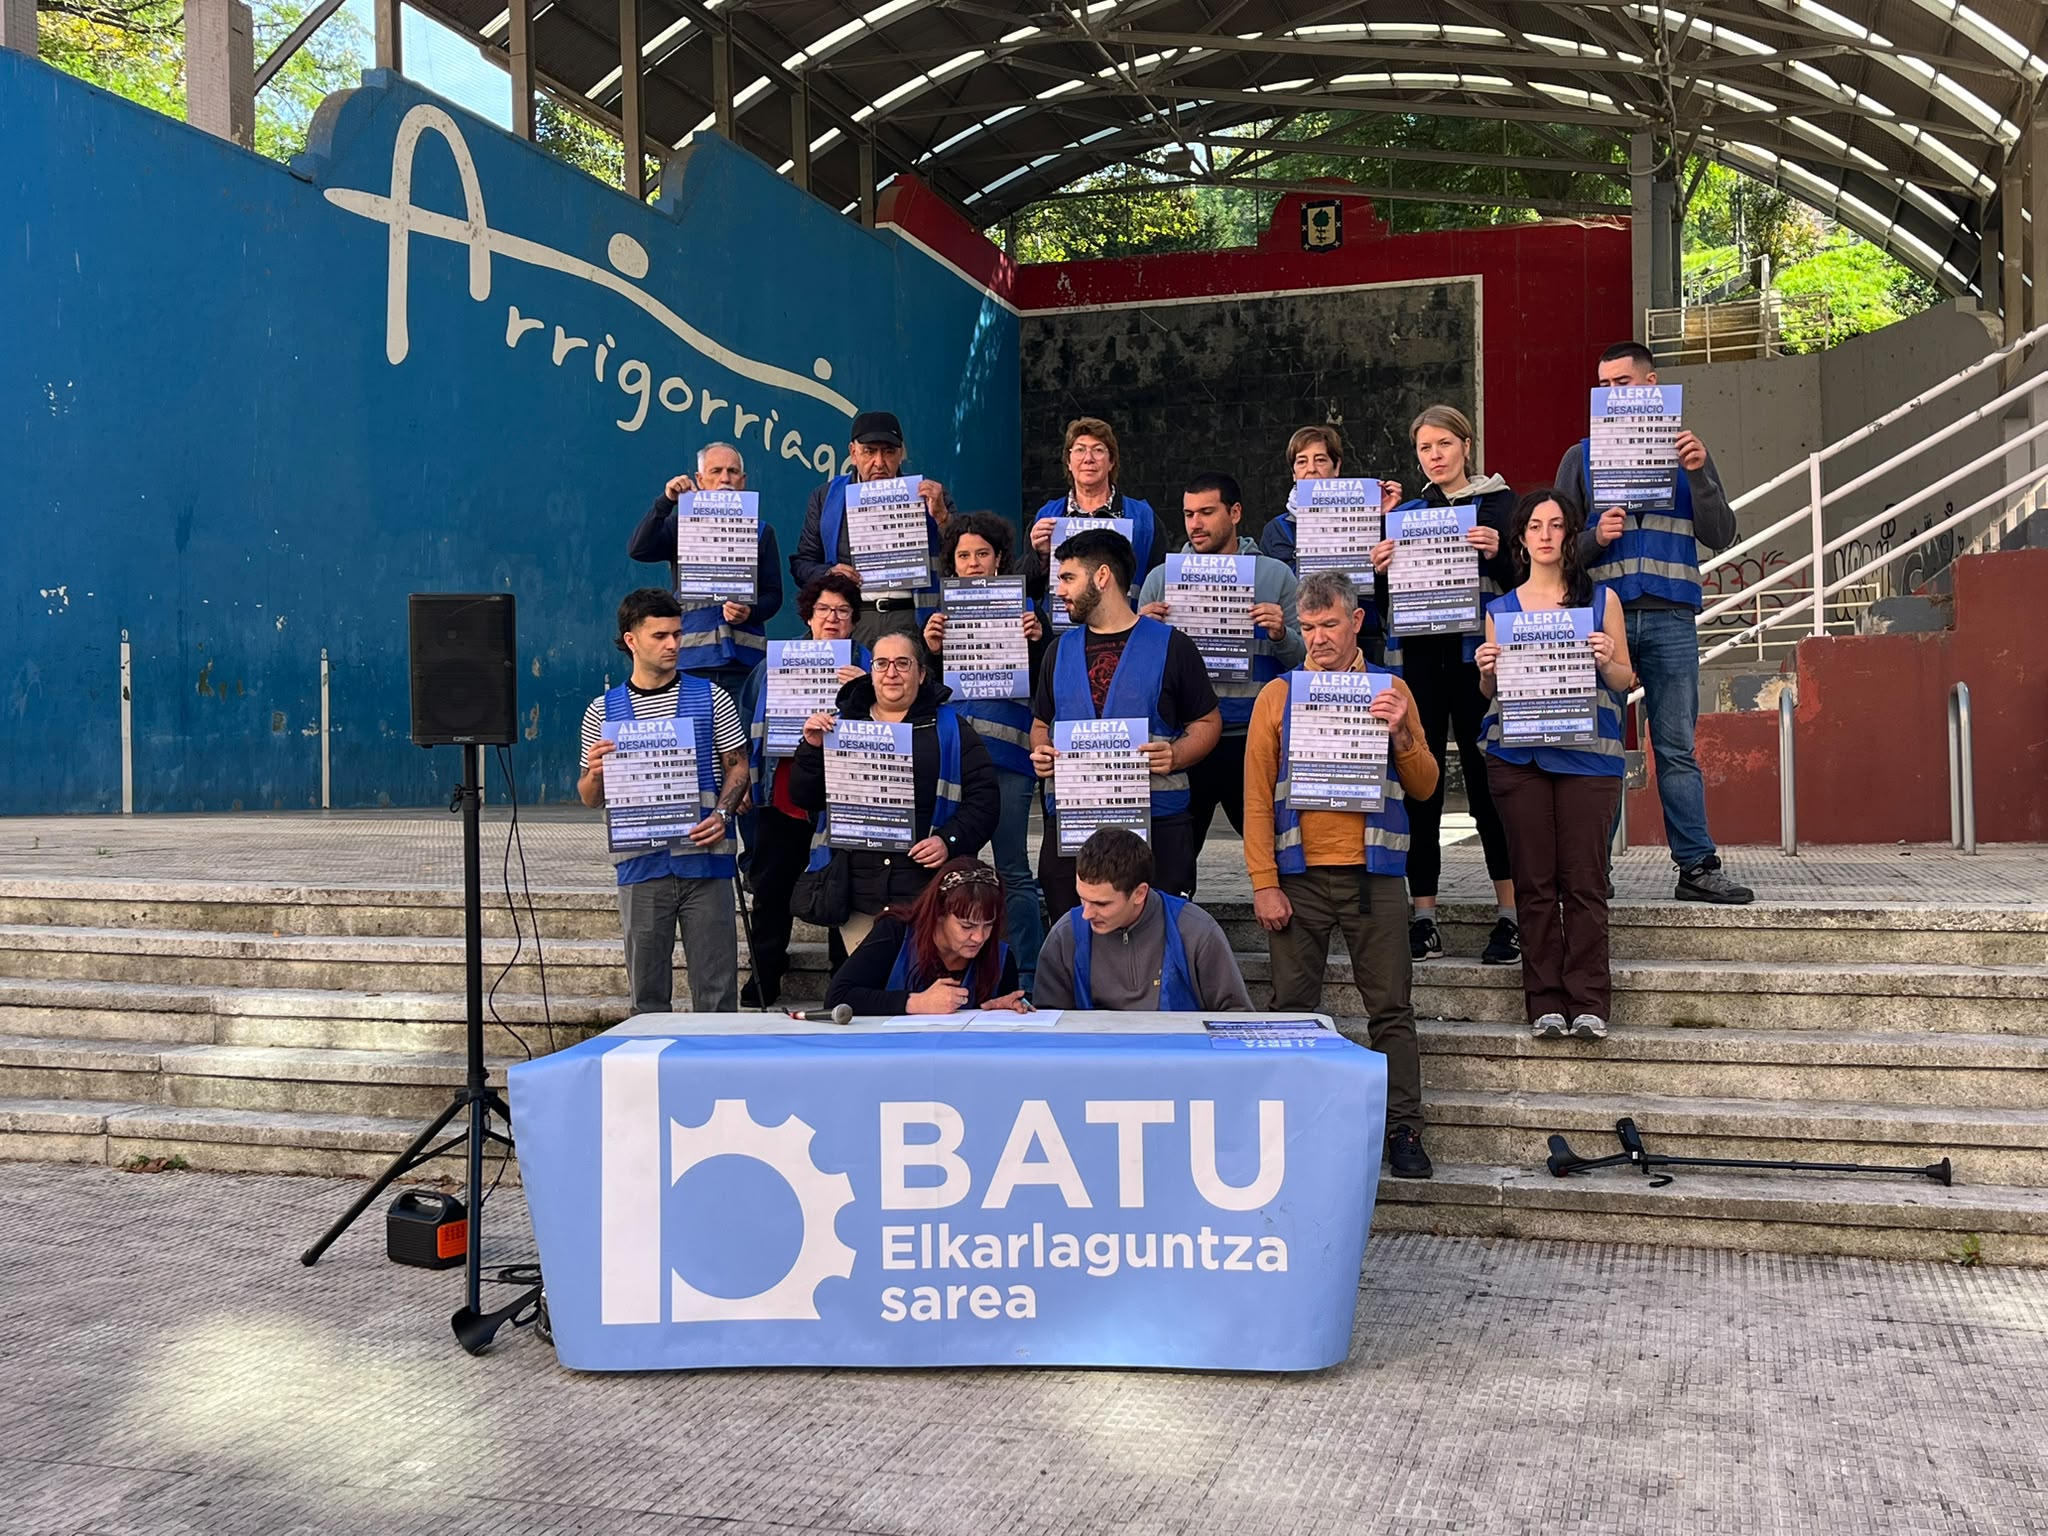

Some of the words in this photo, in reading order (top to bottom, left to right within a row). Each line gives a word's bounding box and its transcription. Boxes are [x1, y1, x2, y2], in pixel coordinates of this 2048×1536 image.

[1608, 388, 1662, 399] ALERTA
[1607, 406, 1663, 414] DESAHUCIO
[861, 479, 907, 492] ALERTA
[1313, 481, 1363, 491] ALERTA
[694, 493, 741, 502] ALERTA
[861, 495, 909, 505] DESAHUCIO
[1312, 497, 1365, 505] DESAHUCIO
[693, 508, 743, 516] DESAHUCIO
[1402, 509, 1456, 522] ALERTA
[1066, 520, 1115, 530] ALERTA
[1403, 526, 1459, 537] DESAHUCIO
[1183, 556, 1236, 567] ALERTA
[1182, 574, 1237, 582] DESAHUCIO
[1513, 612, 1573, 625] ALERTA
[120, 628, 129, 642] 9
[1513, 630, 1575, 641] DESAHUCIO
[782, 642, 833, 651] ALERTA
[783, 658, 835, 666] DESAHUCIO
[960, 672, 1013, 681] DESAHUCIO
[1311, 674, 1370, 686] ALERTA
[962, 687, 1013, 697] ALERTA
[1310, 693, 1371, 703] DESAHUCIO
[618, 721, 674, 734] ALERTA
[839, 721, 893, 736] ALERTA
[1072, 721, 1128, 733] ALERTA
[619, 739, 677, 750] DESAHUCIO
[839, 740, 895, 752] DESAHUCIO
[1072, 740, 1130, 749] DESAHUCIO
[880, 1099, 1285, 1211] BATU
[882, 1223, 1288, 1276] Elkarlaguntza
[881, 1280, 1037, 1321] sarea
